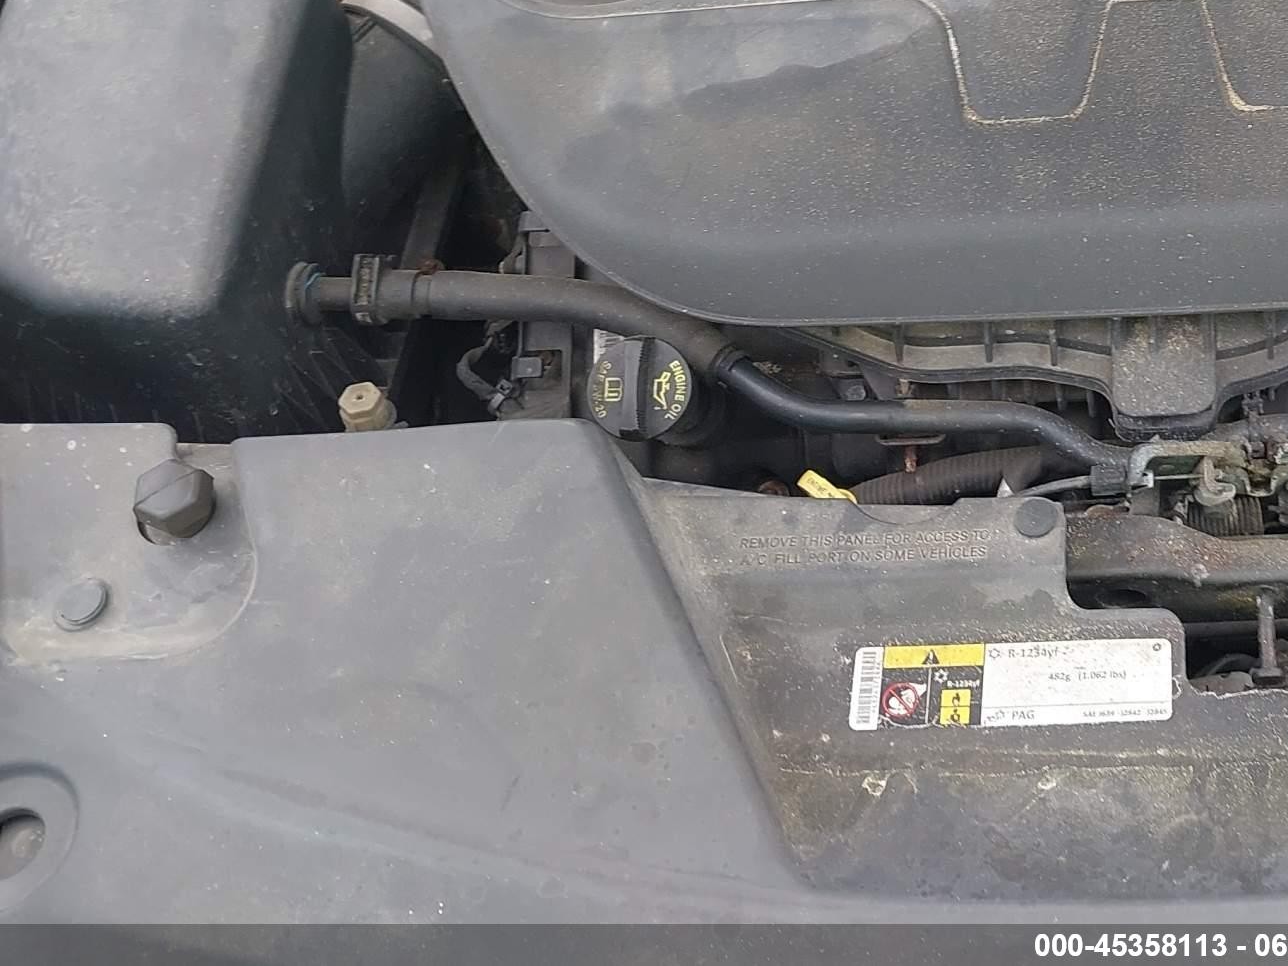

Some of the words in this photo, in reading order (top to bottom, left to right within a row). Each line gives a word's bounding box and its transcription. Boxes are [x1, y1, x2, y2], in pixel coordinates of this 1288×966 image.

[669, 360, 687, 401] ENGINE
[664, 403, 682, 420] OIL
[740, 536, 797, 549] REMOVE
[803, 535, 832, 548] THIS
[885, 533, 912, 546] FOR
[916, 530, 968, 545] ACCESS
[973, 528, 990, 542] TO
[775, 552, 801, 565] FILL
[808, 551, 843, 564] PORT
[850, 549, 872, 563] ON
[875, 548, 915, 562] SOME
[921, 545, 987, 560] VEHICLES
[1011, 709, 1035, 721] PAG
